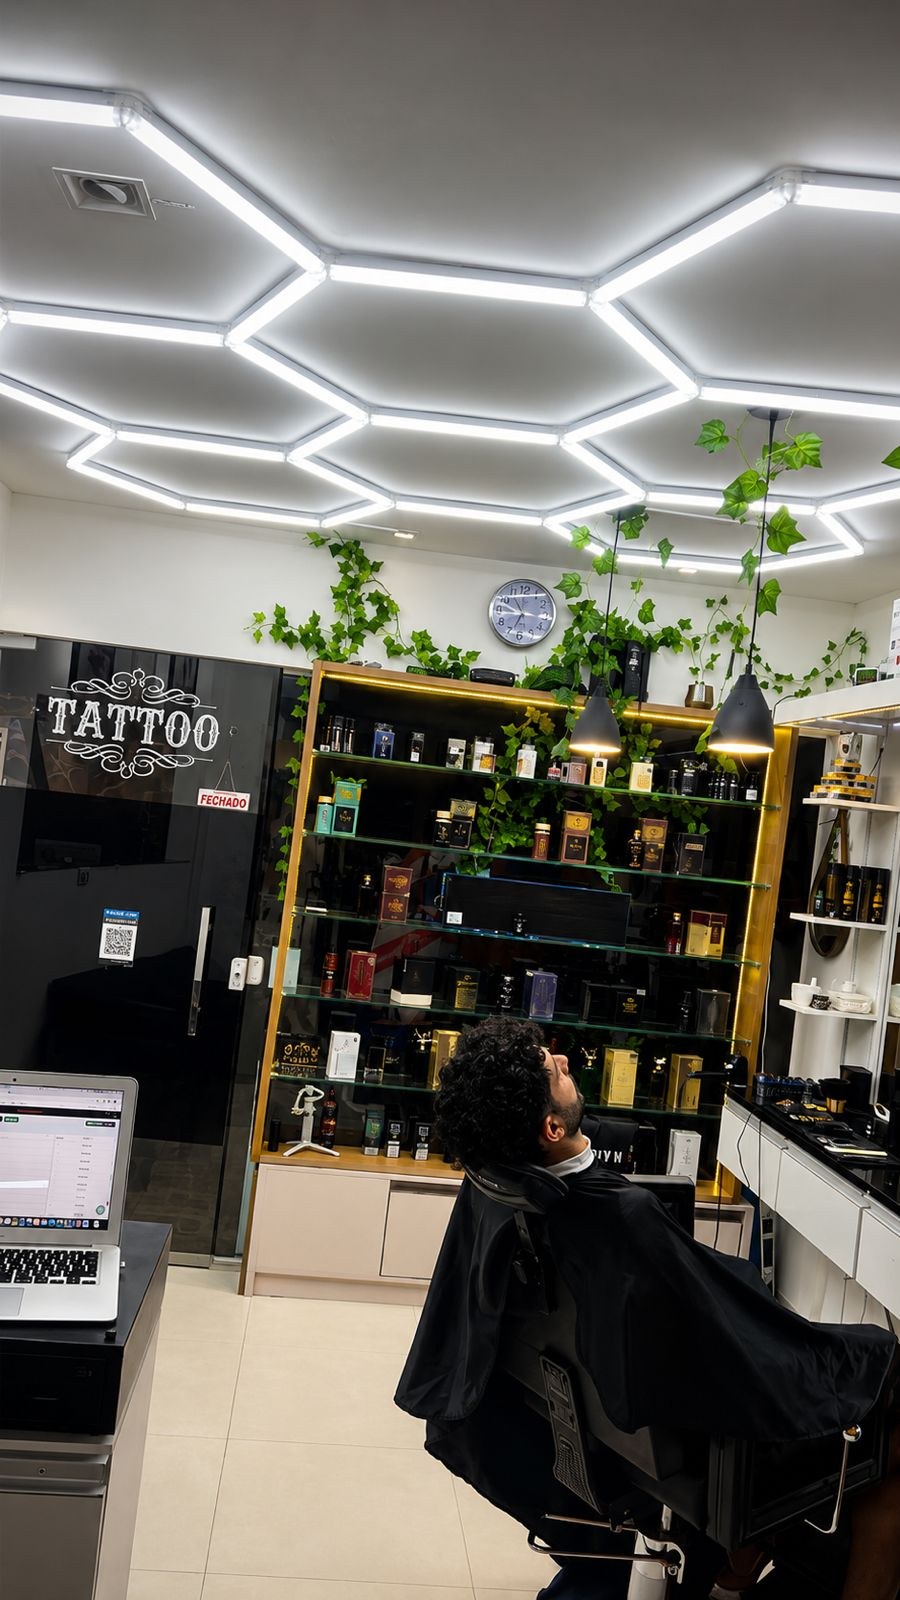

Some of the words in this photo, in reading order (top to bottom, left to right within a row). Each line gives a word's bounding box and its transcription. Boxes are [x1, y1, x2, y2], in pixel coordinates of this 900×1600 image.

[520, 585, 531, 595] 12
[540, 600, 546, 609] 2
[498, 617, 505, 626] 8
[516, 631, 523, 640] 6
[48, 696, 220, 752] TATTOO
[200, 794, 247, 809] FECHADO
